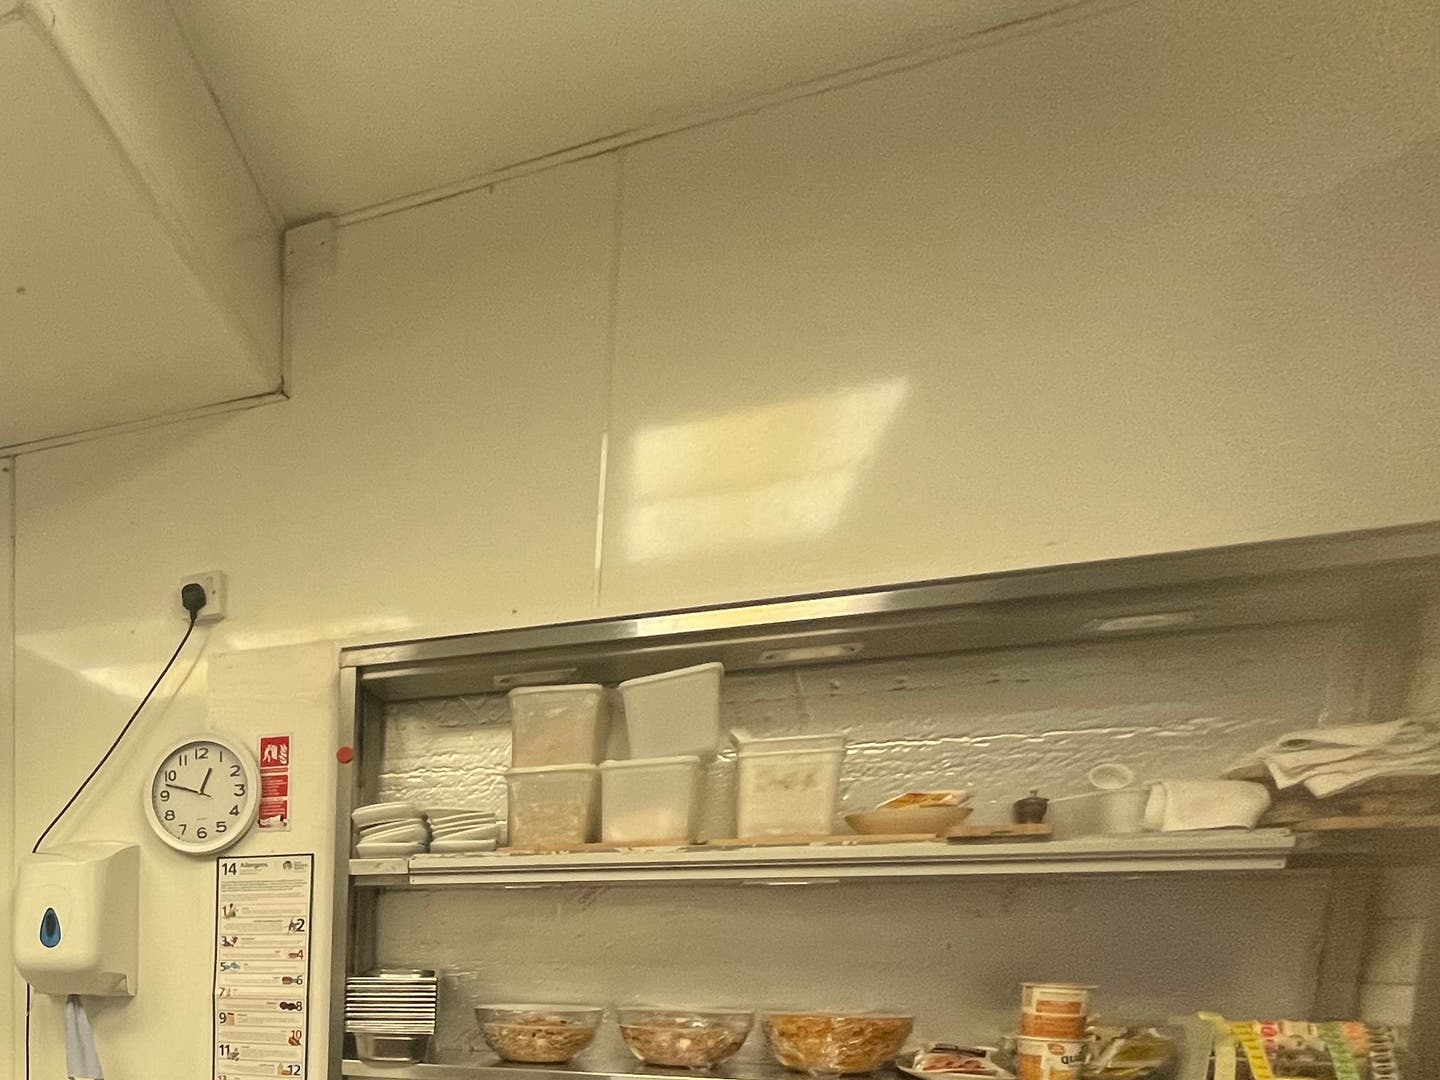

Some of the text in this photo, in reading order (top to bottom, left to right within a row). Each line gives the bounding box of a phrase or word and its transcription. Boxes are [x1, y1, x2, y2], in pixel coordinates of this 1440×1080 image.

[195, 748, 209, 760] 12
[179, 755, 187, 766] 11
[164, 770, 177, 781] 10
[230, 765, 241, 777] 2
[160, 790, 170, 802] 9
[233, 784, 246, 797] 3
[164, 809, 176, 821] 8
[229, 804, 240, 817] 4
[178, 824, 187, 836] 7
[197, 827, 208, 839] 6
[216, 821, 227, 833] 5
[221, 862, 237, 876] 14
[287, 1064, 301, 1076] 12
